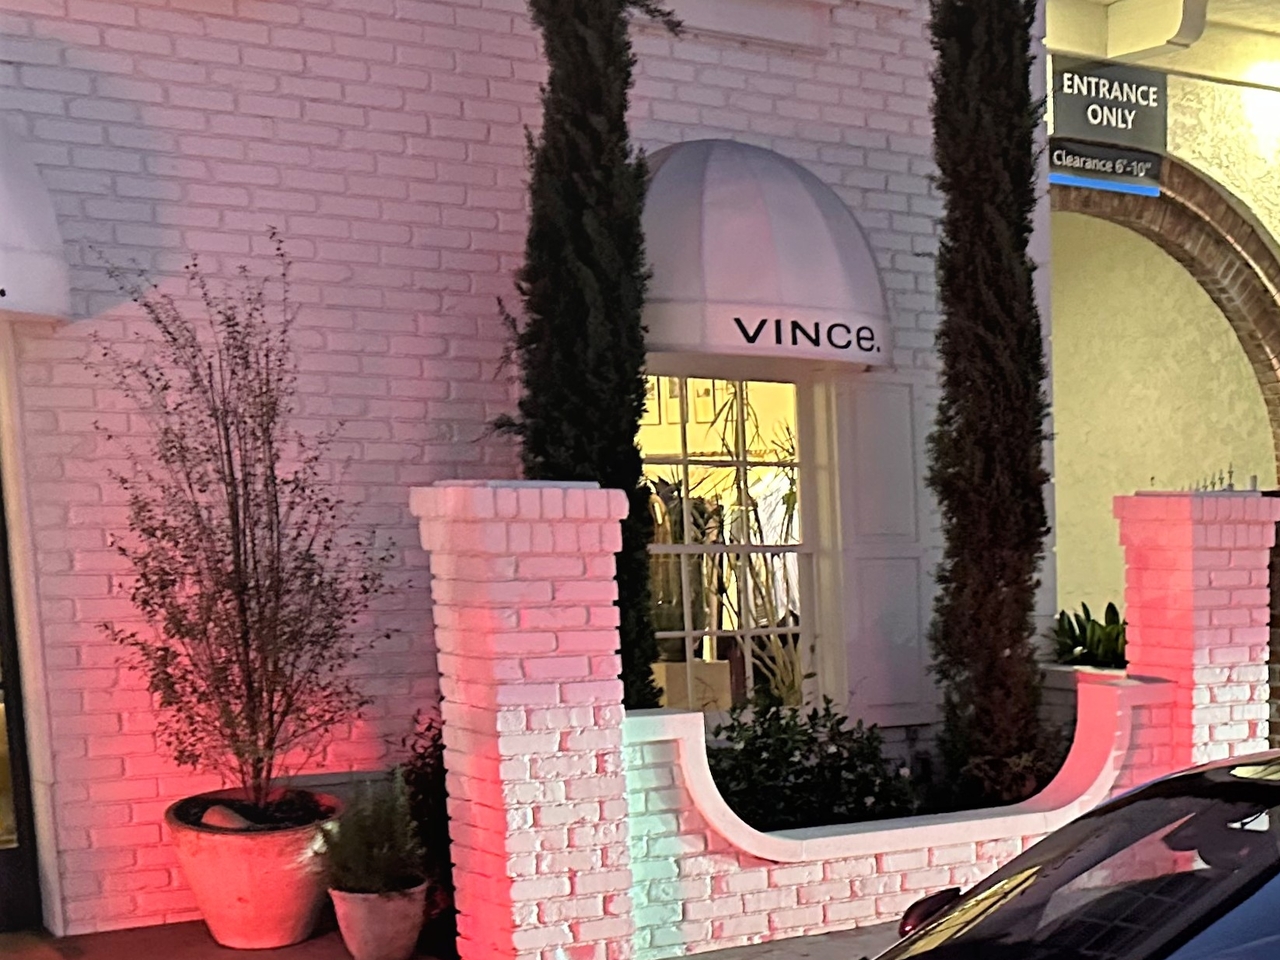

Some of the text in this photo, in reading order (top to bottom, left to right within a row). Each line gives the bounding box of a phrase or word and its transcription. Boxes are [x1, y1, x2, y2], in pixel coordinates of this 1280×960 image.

[1063, 72, 1158, 107] ENTRANCE
[1087, 104, 1136, 129] ONLY
[1053, 149, 1113, 172] Clearance
